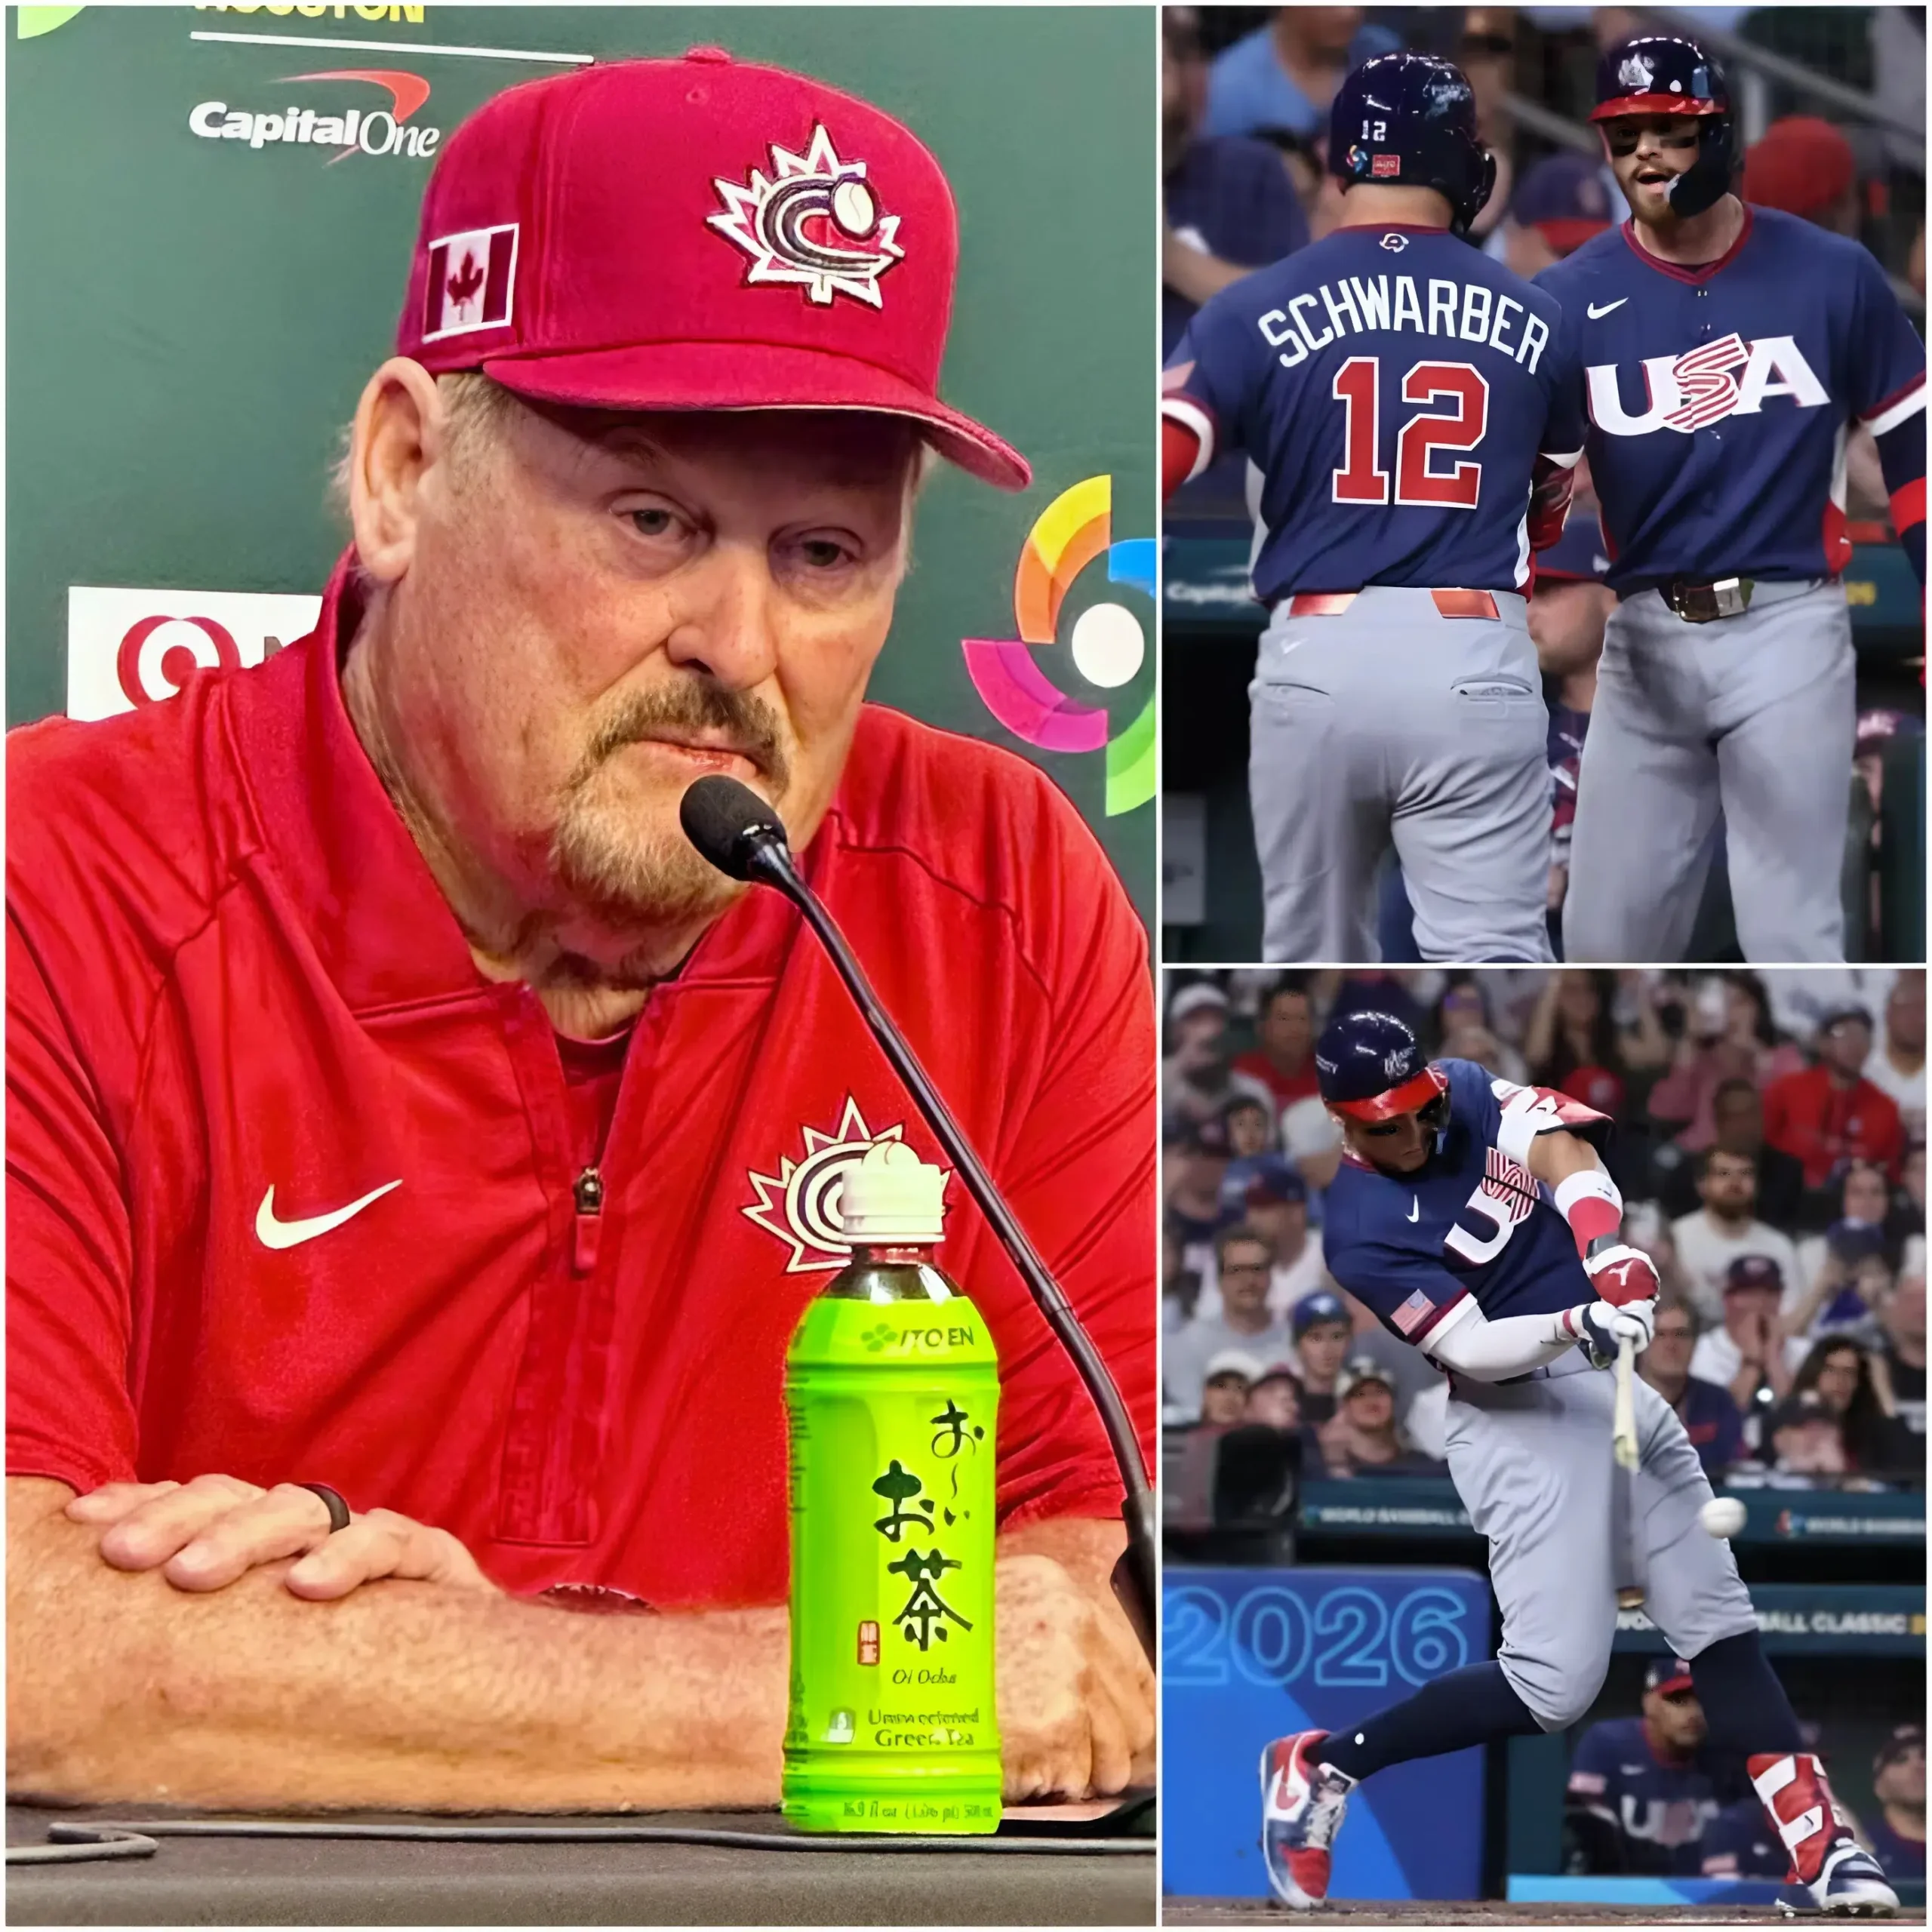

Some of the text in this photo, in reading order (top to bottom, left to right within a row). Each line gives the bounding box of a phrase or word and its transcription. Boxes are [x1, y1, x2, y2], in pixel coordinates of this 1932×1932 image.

[1361, 119, 1387, 142] 12
[1257, 275, 1549, 375] SCHWARBER
[1331, 356, 1490, 509] 12
[1586, 332, 1831, 435] USA
[1162, 1586, 1468, 1687] 2026
